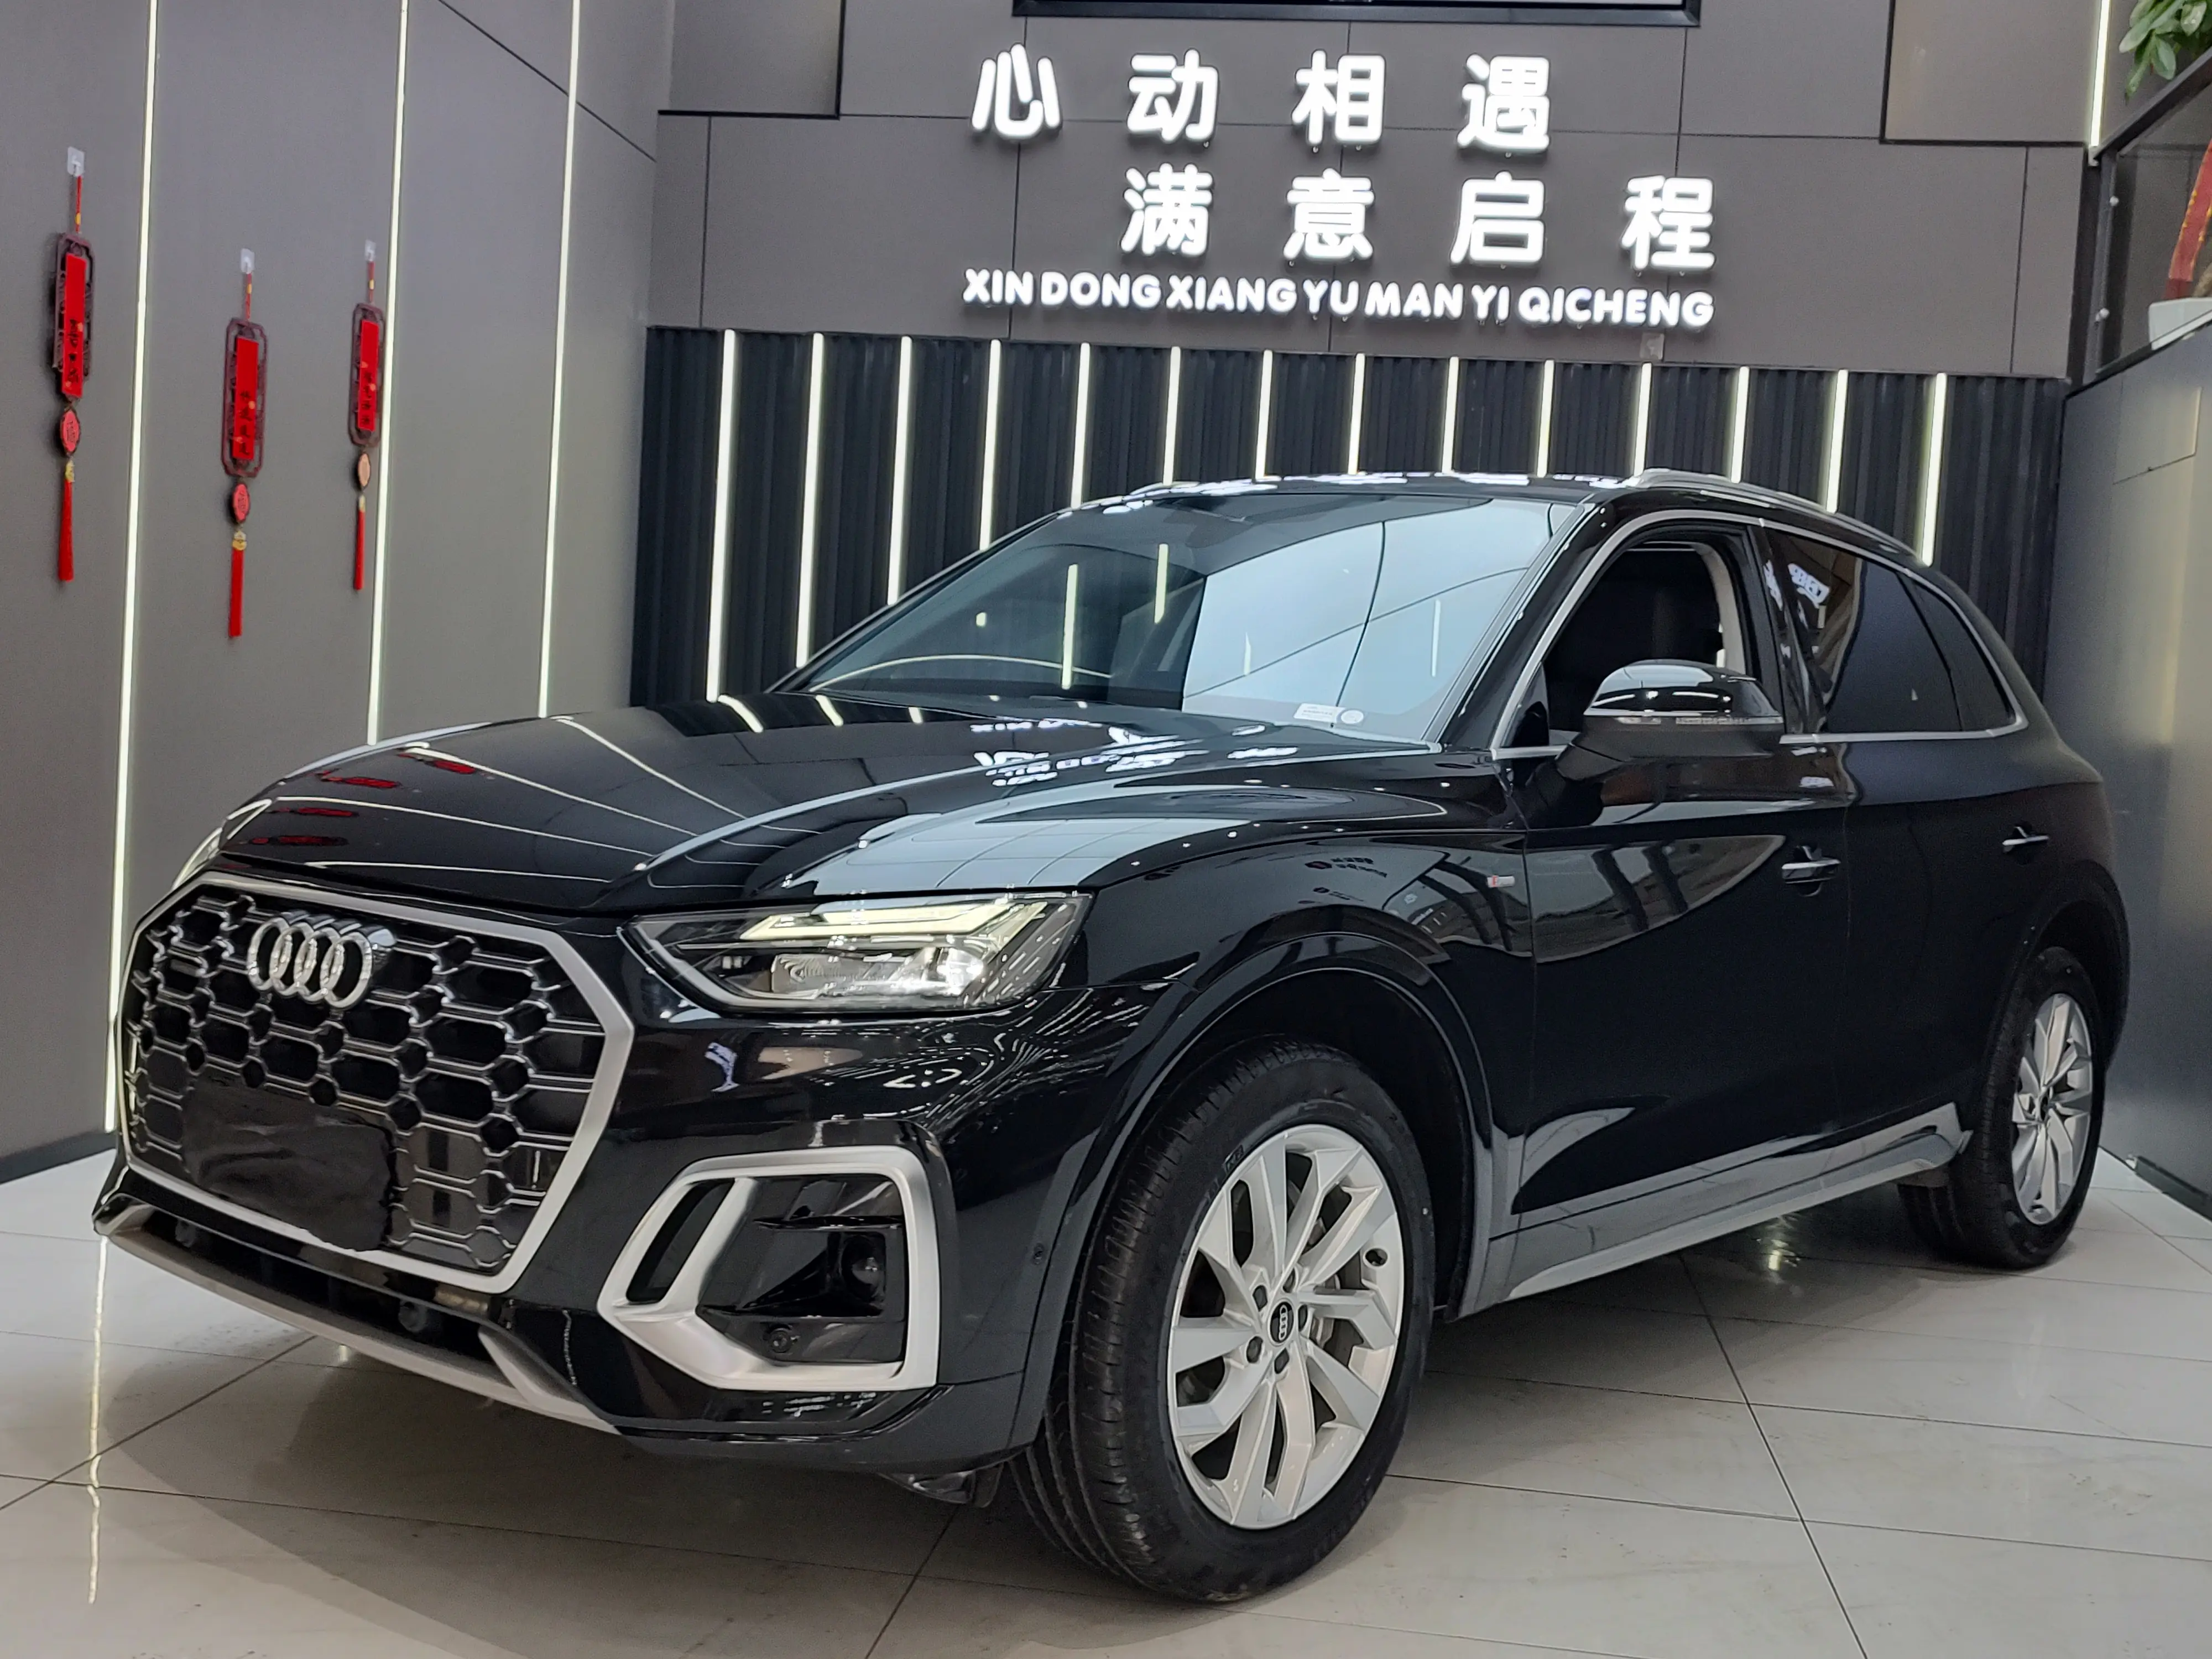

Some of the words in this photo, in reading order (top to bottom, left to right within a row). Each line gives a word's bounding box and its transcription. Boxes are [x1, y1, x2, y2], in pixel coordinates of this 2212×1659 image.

[971, 43, 1550, 151] 心动相遇
[1120, 162, 1715, 270] 满意启程
[962, 268, 1034, 306] XIN
[1040, 270, 1162, 309] DONG
[1165, 274, 1298, 314] XIANG
[1302, 279, 1360, 316] YU
[1363, 281, 1464, 319] MAN
[1470, 284, 1510, 321] YI
[1517, 286, 1715, 327] QICHENG
